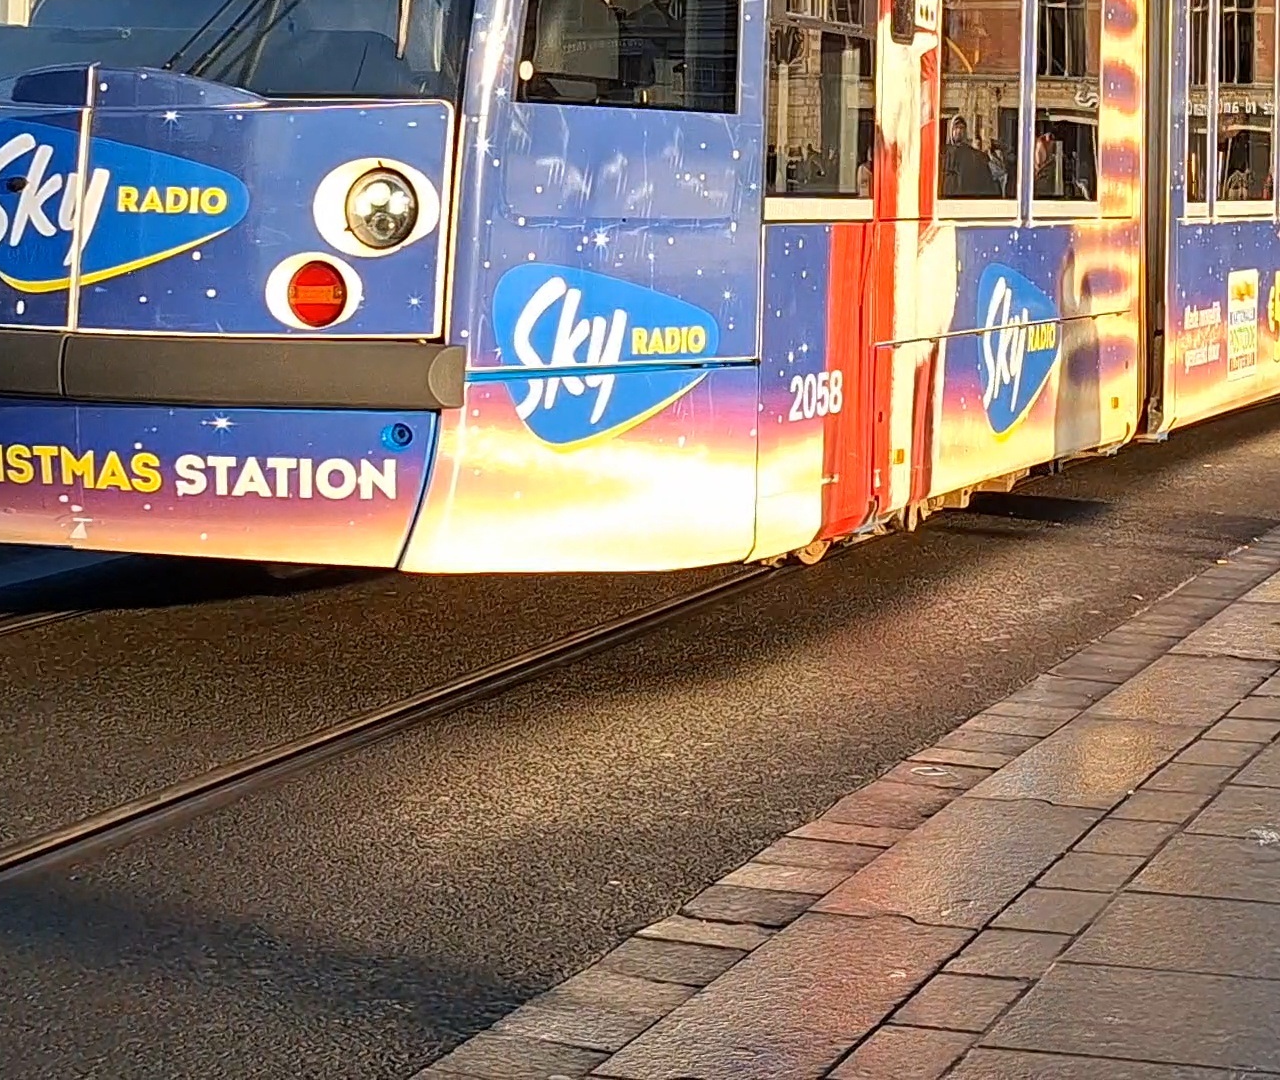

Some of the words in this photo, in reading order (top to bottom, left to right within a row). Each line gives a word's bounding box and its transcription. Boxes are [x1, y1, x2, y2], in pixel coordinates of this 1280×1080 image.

[117, 186, 228, 215] RADIO
[514, 276, 628, 425] Sky
[631, 324, 707, 355] RADIO
[982, 276, 1029, 413] Sky
[1027, 322, 1057, 353] RADIO
[788, 369, 844, 422] 2058
[174, 454, 398, 501] STATION
